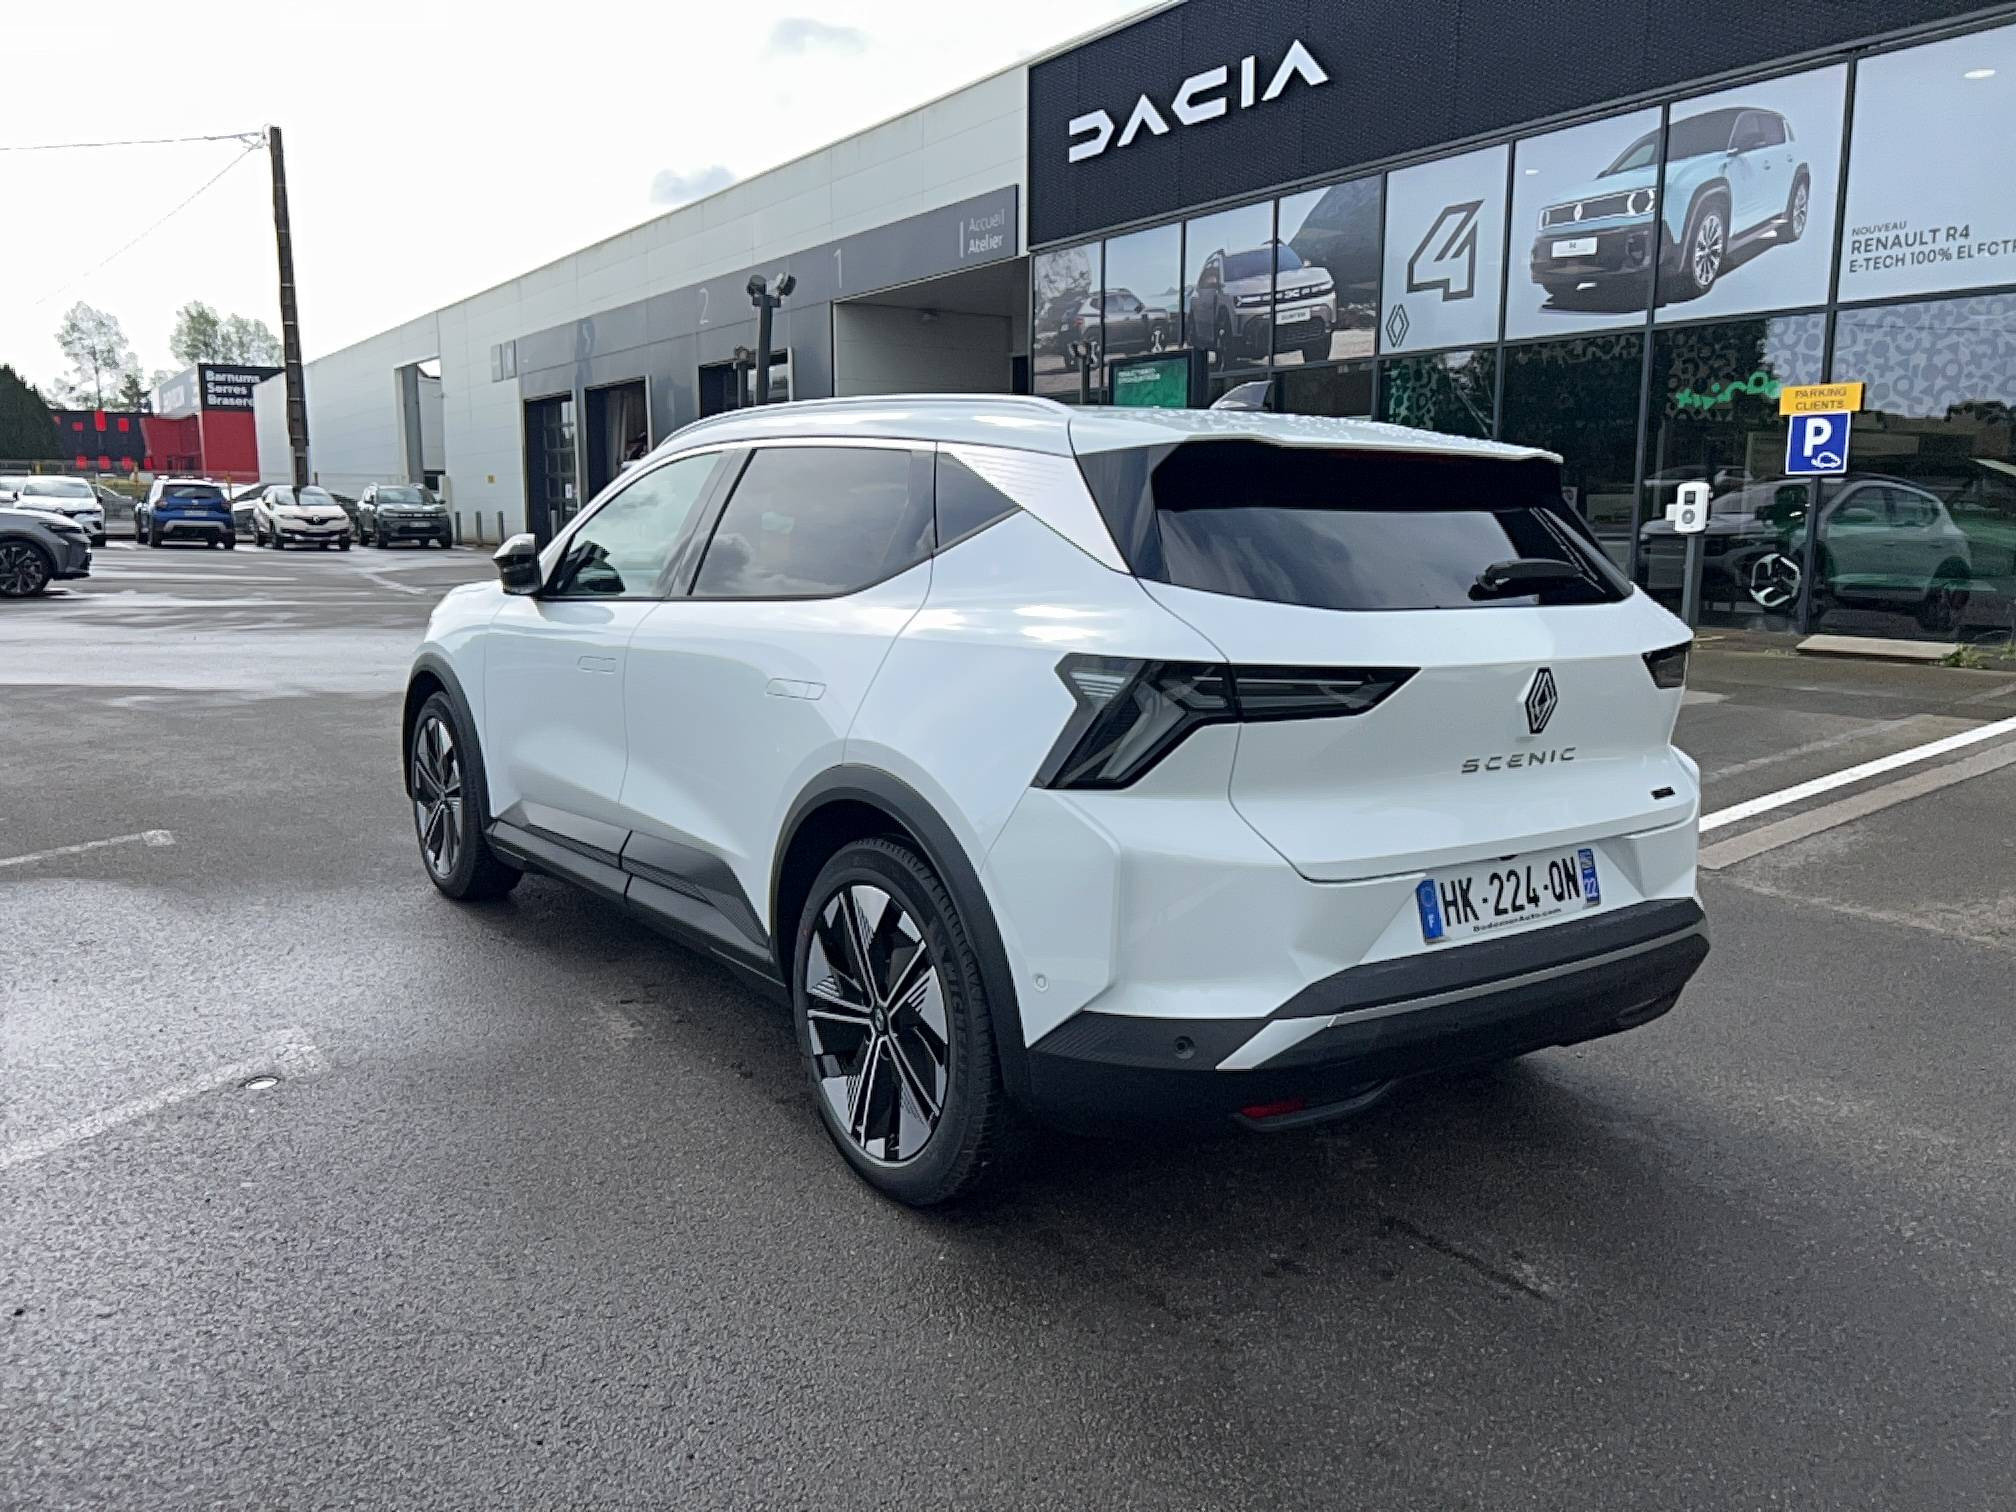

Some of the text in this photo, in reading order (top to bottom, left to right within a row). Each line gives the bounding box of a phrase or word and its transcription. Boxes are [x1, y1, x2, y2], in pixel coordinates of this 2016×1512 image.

[1068, 38, 1330, 164] DACIA
[968, 208, 1006, 233] Accueil
[1851, 220, 1907, 237] NOUVEAU
[967, 234, 1004, 254] Atelier
[1850, 224, 1970, 255] RENAULT R4
[833, 247, 843, 289] 1
[1848, 252, 1906, 274] E-TECH
[1910, 246, 1953, 266] 100%
[699, 287, 710, 325] 2
[205, 370, 261, 384] Barnums
[206, 381, 248, 395] Serres
[1795, 386, 1847, 399] PARKING
[1795, 400, 1845, 411] CLIENTS
[1803, 417, 1832, 458] P
[1461, 747, 1576, 774] SCENIC
